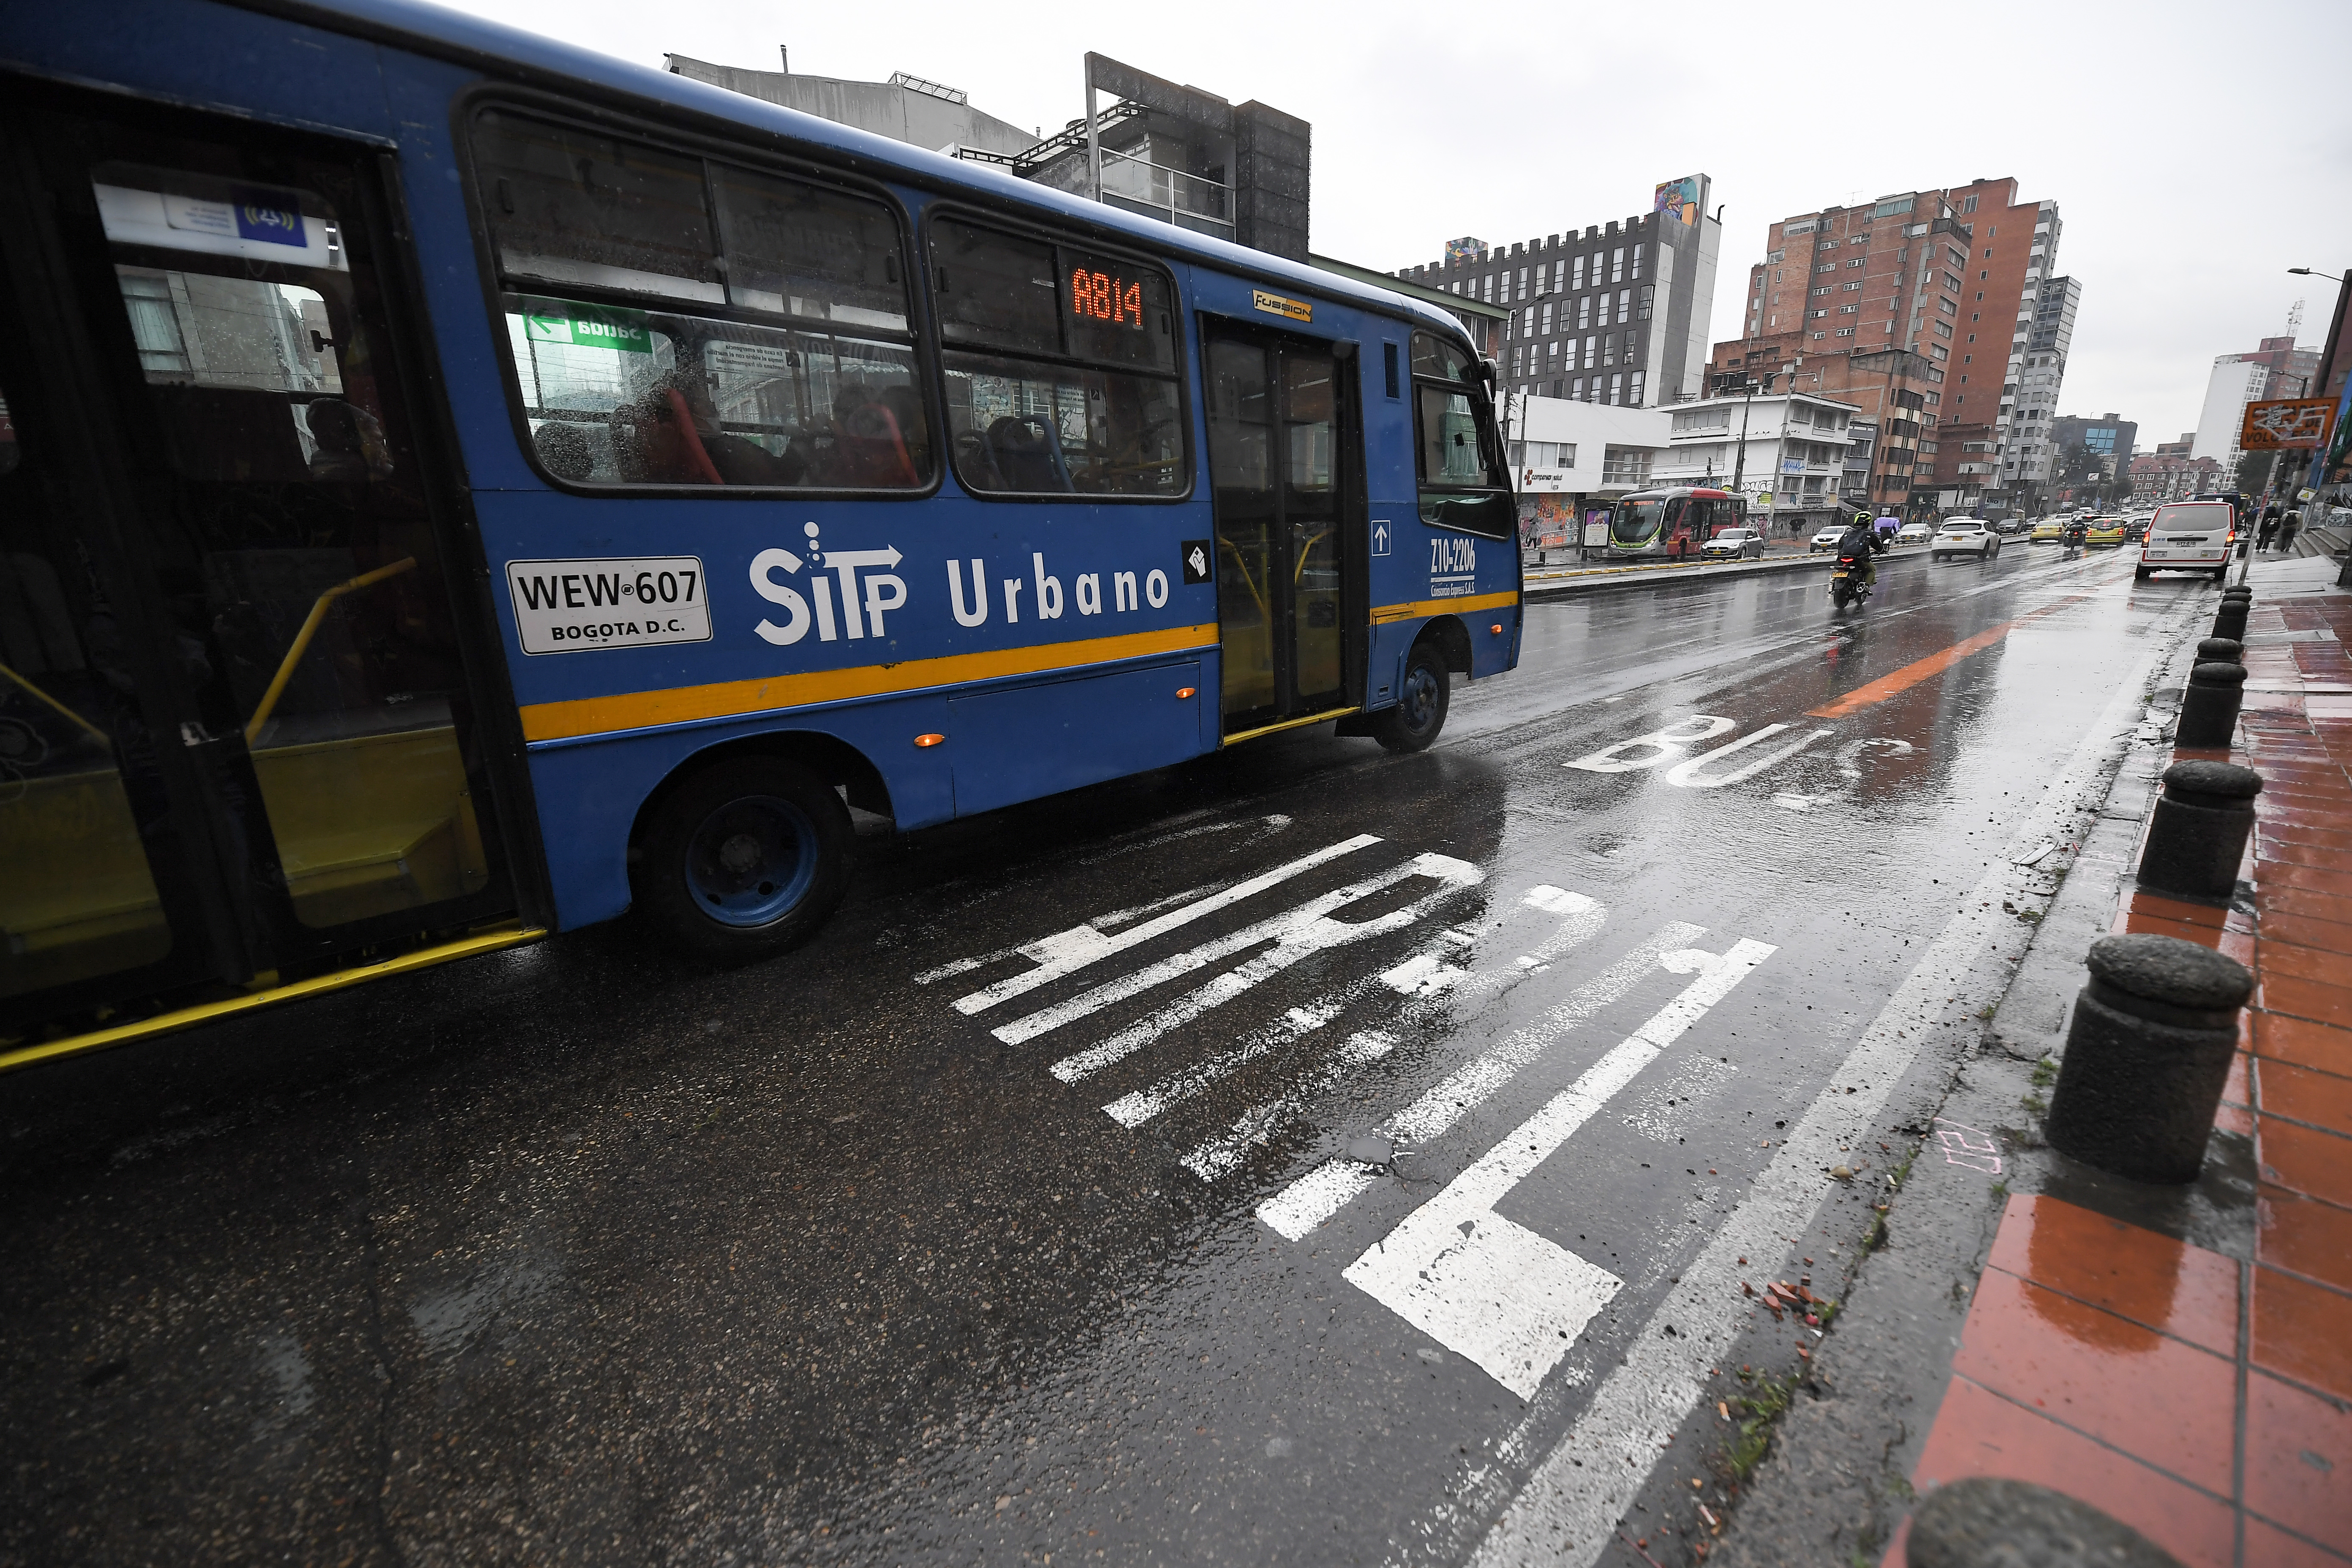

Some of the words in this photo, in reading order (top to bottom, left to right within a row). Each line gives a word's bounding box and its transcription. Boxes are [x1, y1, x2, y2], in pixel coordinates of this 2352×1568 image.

[1073, 268, 1141, 325] A814
[1430, 538, 1475, 573] Z10-2206
[946, 552, 1169, 627] Urbano
[1431, 584, 1450, 597] Consorcio
[1451, 583, 1465, 598] Express
[1465, 581, 1475, 594] S.A.S.
[551, 621, 640, 641] BOGOTA
[645, 618, 686, 635] D.C.
